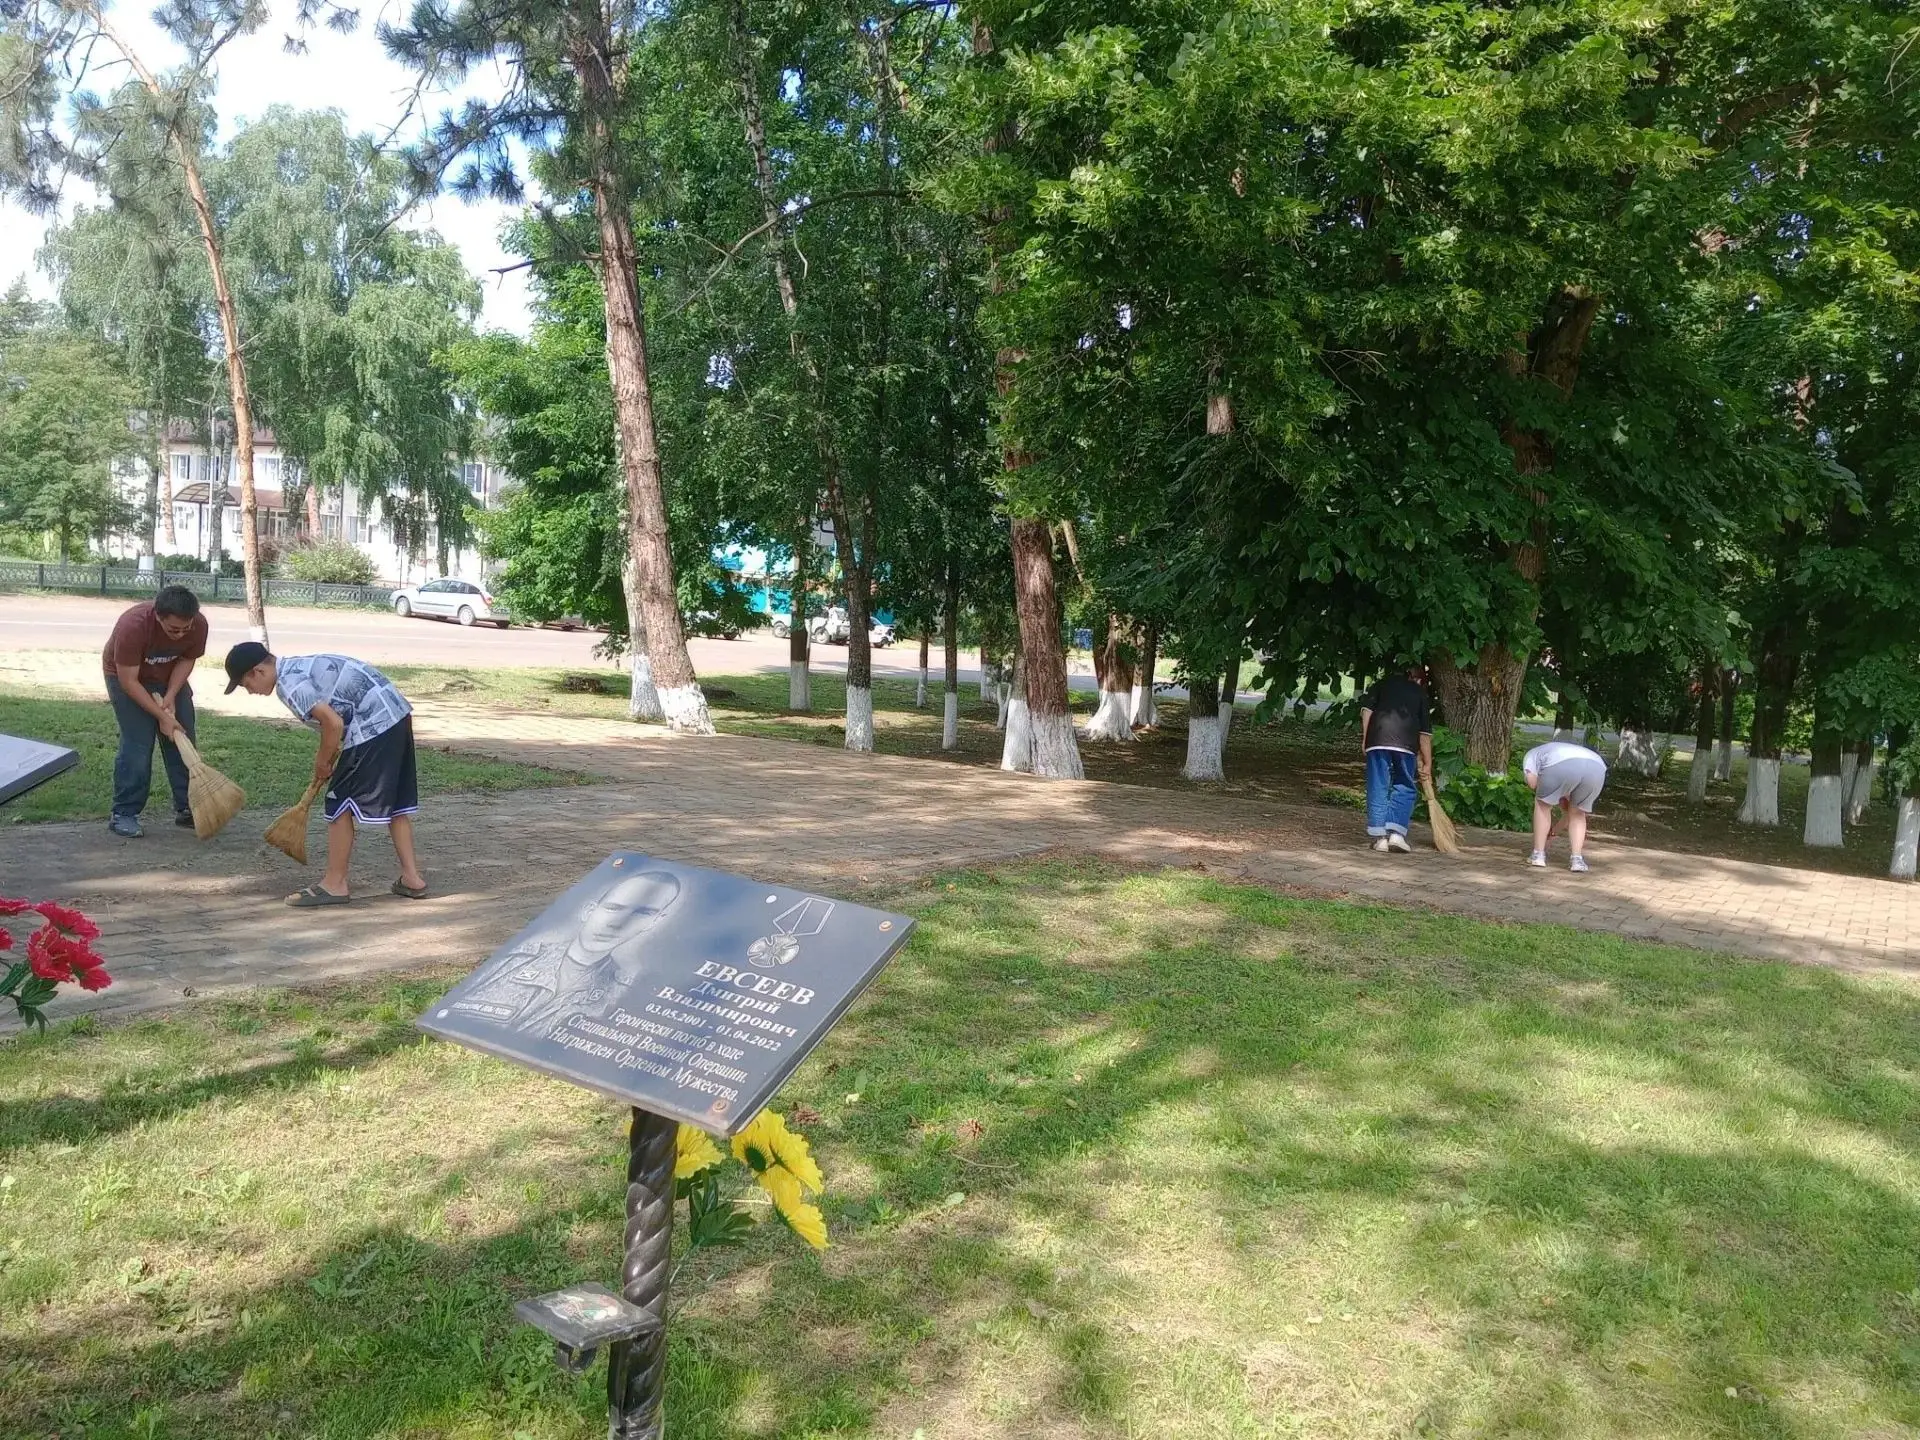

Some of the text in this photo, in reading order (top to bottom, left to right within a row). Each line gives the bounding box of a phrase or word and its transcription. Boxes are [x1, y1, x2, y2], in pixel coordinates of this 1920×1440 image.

[689, 981, 781, 1014] Дмитрий
[693, 960, 815, 1005] ЕВСЕЕВ
[608, 1007, 671, 1038] Героически
[671, 1030, 712, 1048] погиб
[716, 1044, 745, 1061] ходе
[645, 1003, 707, 1028] 03.05.2001
[716, 1025, 782, 1051] 01.04.2022
[656, 987, 798, 1037] Владимирович
[548, 1026, 740, 1103] Награжден Орденом Мужества.
[567, 1014, 748, 1084] Специальной Военной Операции.
